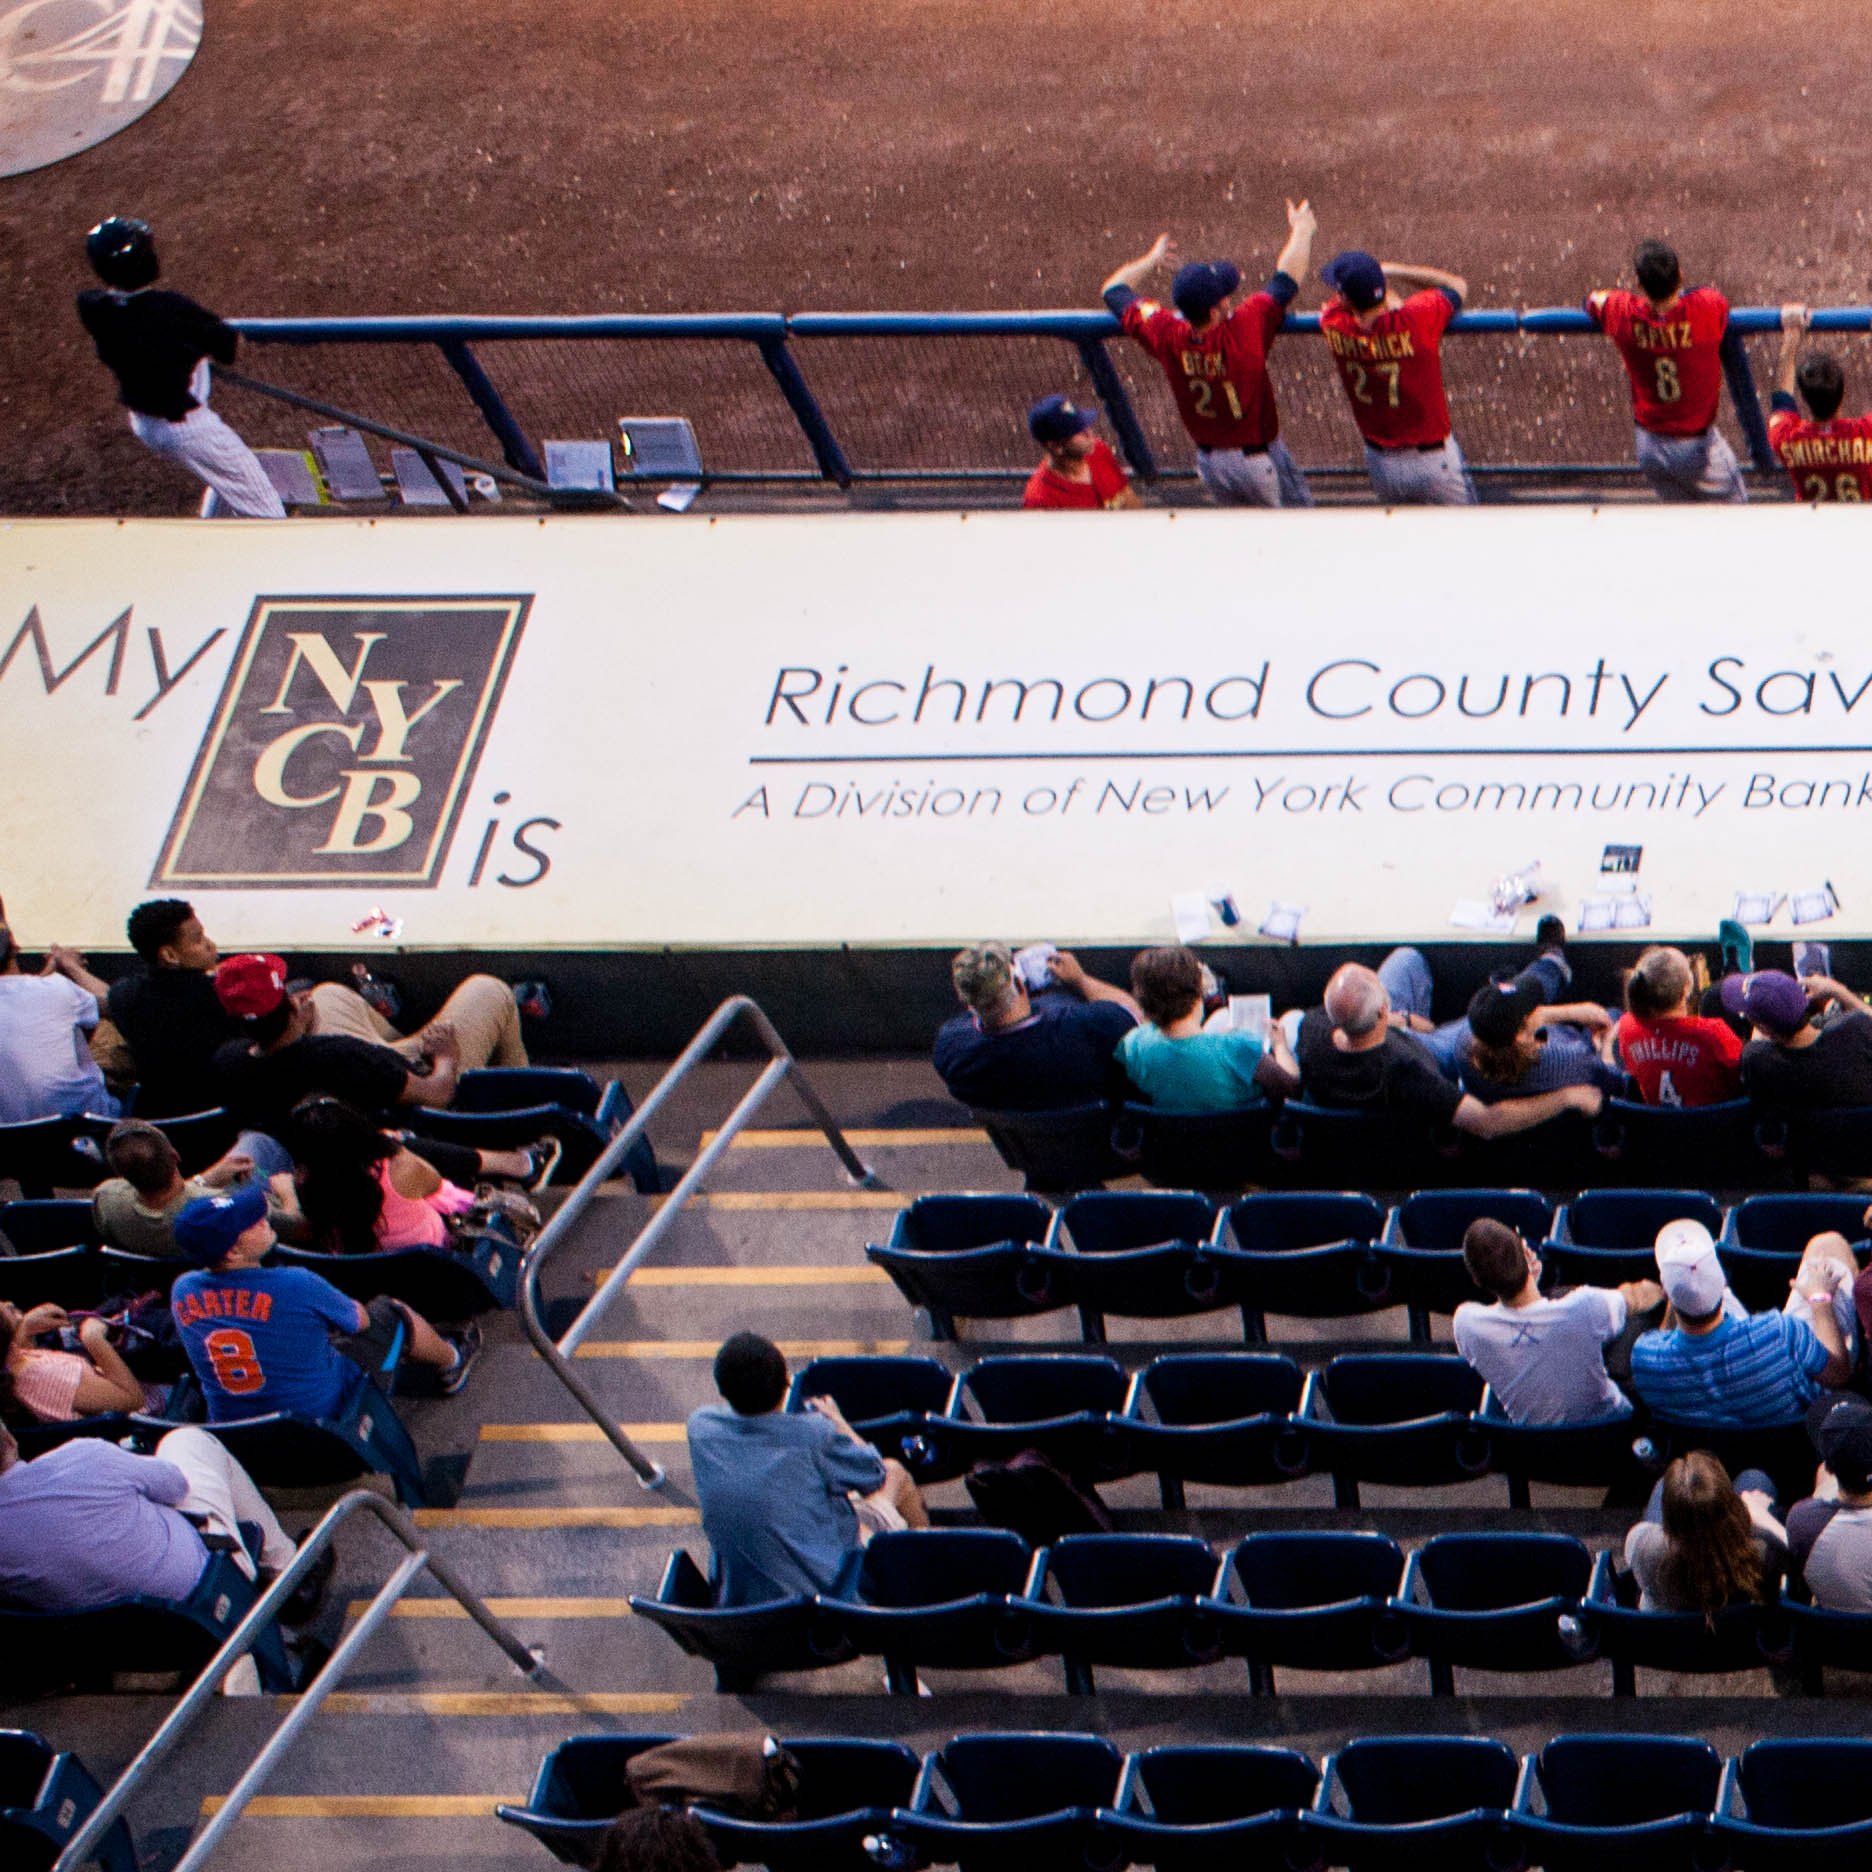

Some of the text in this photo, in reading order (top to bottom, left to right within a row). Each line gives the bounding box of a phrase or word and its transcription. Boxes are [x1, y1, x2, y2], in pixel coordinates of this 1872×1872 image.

[1189, 378, 1244, 420] 21
[1344, 360, 1401, 410] 27
[1655, 356, 1682, 402] 8
[0, 604, 228, 720] My
[765, 661, 1270, 727] Richmond
[1305, 658, 1670, 730] County
[731, 783, 771, 819] A
[793, 779, 1002, 819] Division
[1022, 777, 1088, 816] of
[1095, 779, 1230, 815] New
[1252, 775, 1369, 813] York
[1387, 772, 1730, 819] Community
[467, 791, 563, 888] is
[1658, 1069, 1683, 1109] 4
[175, 1289, 273, 1328] CARTER
[204, 1327, 267, 1396] 8
